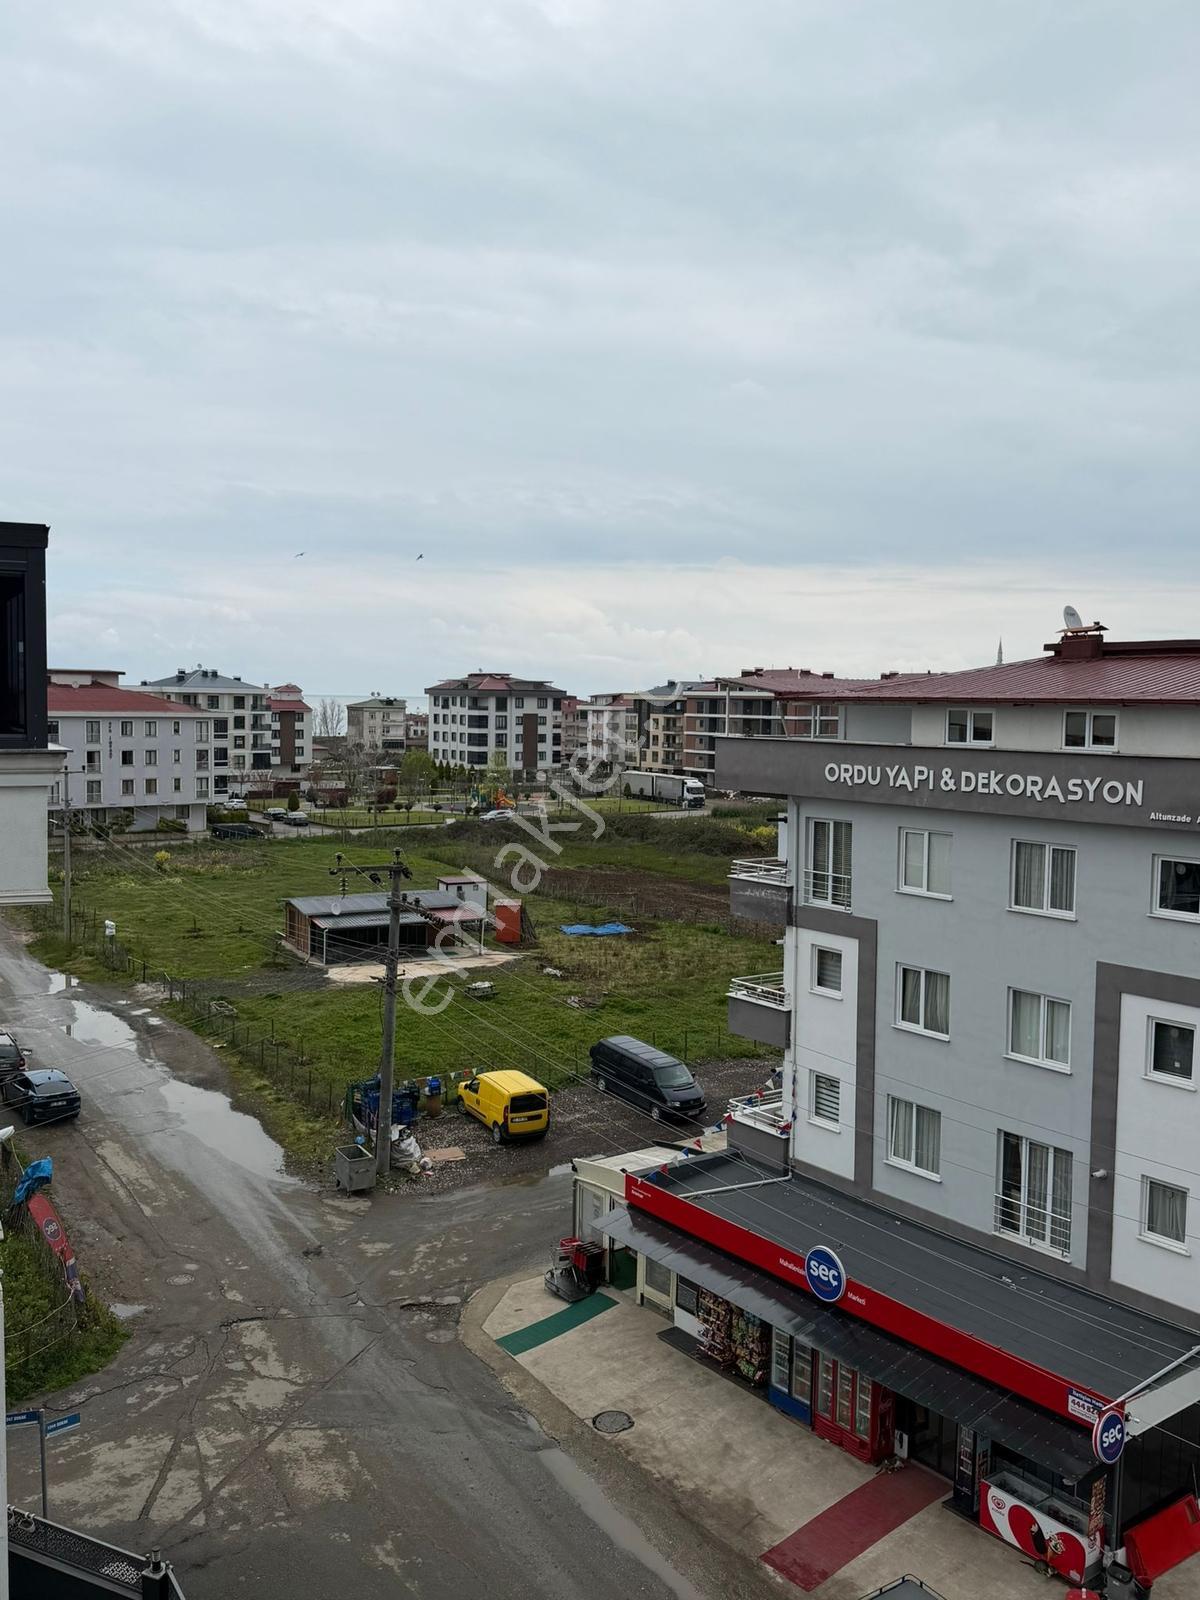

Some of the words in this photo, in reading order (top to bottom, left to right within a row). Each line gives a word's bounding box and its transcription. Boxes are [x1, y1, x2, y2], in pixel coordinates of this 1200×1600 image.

[824, 763, 881, 786] ORDU
[885, 765, 934, 792] YAPI
[940, 767, 957, 792] &
[961, 770, 1144, 806] DEKORASYON
[1150, 812, 1192, 823] Altunzade
[809, 1260, 838, 1287] seç
[1102, 1424, 1122, 1448] seç
